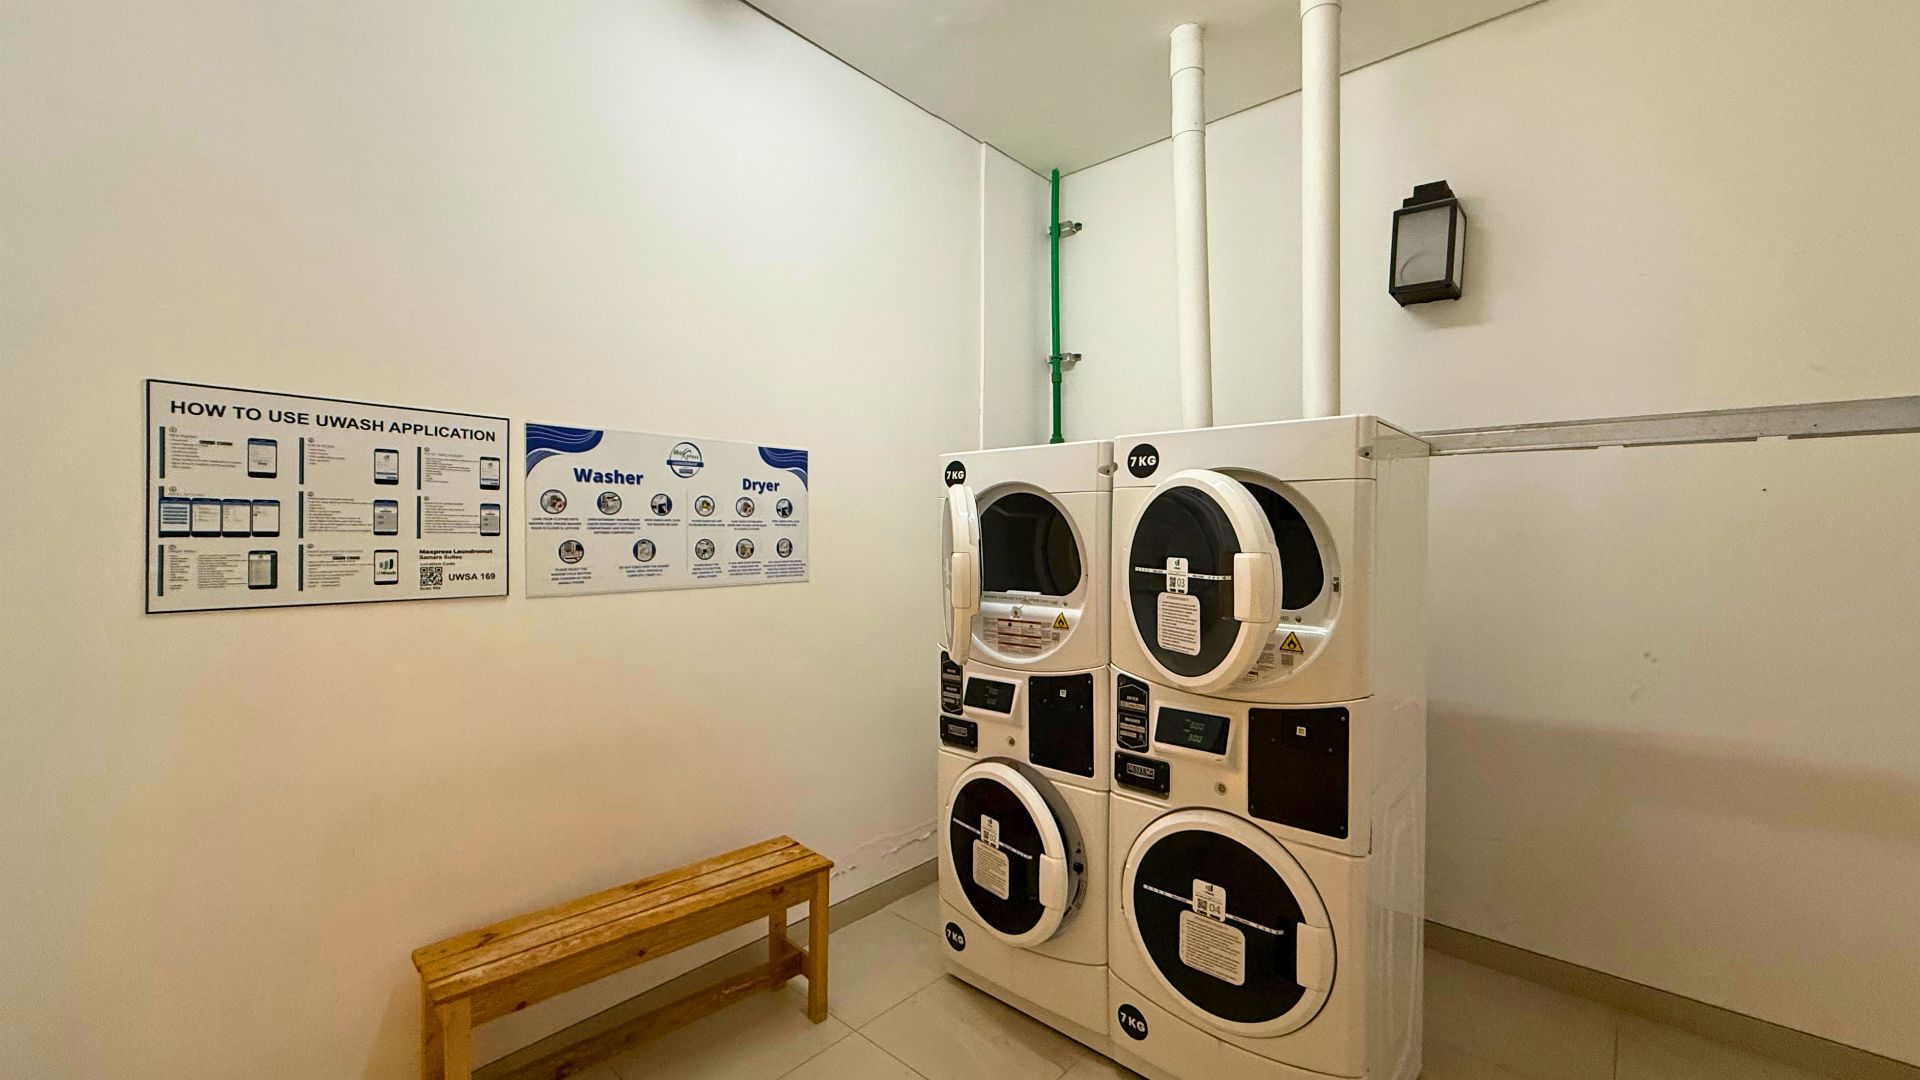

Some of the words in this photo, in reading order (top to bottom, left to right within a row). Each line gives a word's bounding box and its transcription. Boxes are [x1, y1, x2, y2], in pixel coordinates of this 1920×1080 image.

[170, 400, 226, 418] HOW
[232, 406, 262, 421] TO
[268, 410, 310, 425] USE
[316, 414, 384, 432] UWASH
[389, 421, 496, 442] APPLICATION
[1130, 457, 1137, 467] 7
[1138, 456, 1157, 467] KG
[573, 467, 644, 486] Washer
[952, 470, 965, 480] KG
[742, 478, 780, 494] Dryer
[448, 573, 478, 581] UWSA
[480, 572, 496, 581] 169
[1176, 578, 1185, 588] 03
[1208, 903, 1221, 914] 04
[946, 929, 952, 938] 7
[952, 932, 965, 945] KG
[1120, 1012, 1127, 1022] 7
[1128, 1016, 1146, 1033] KG
